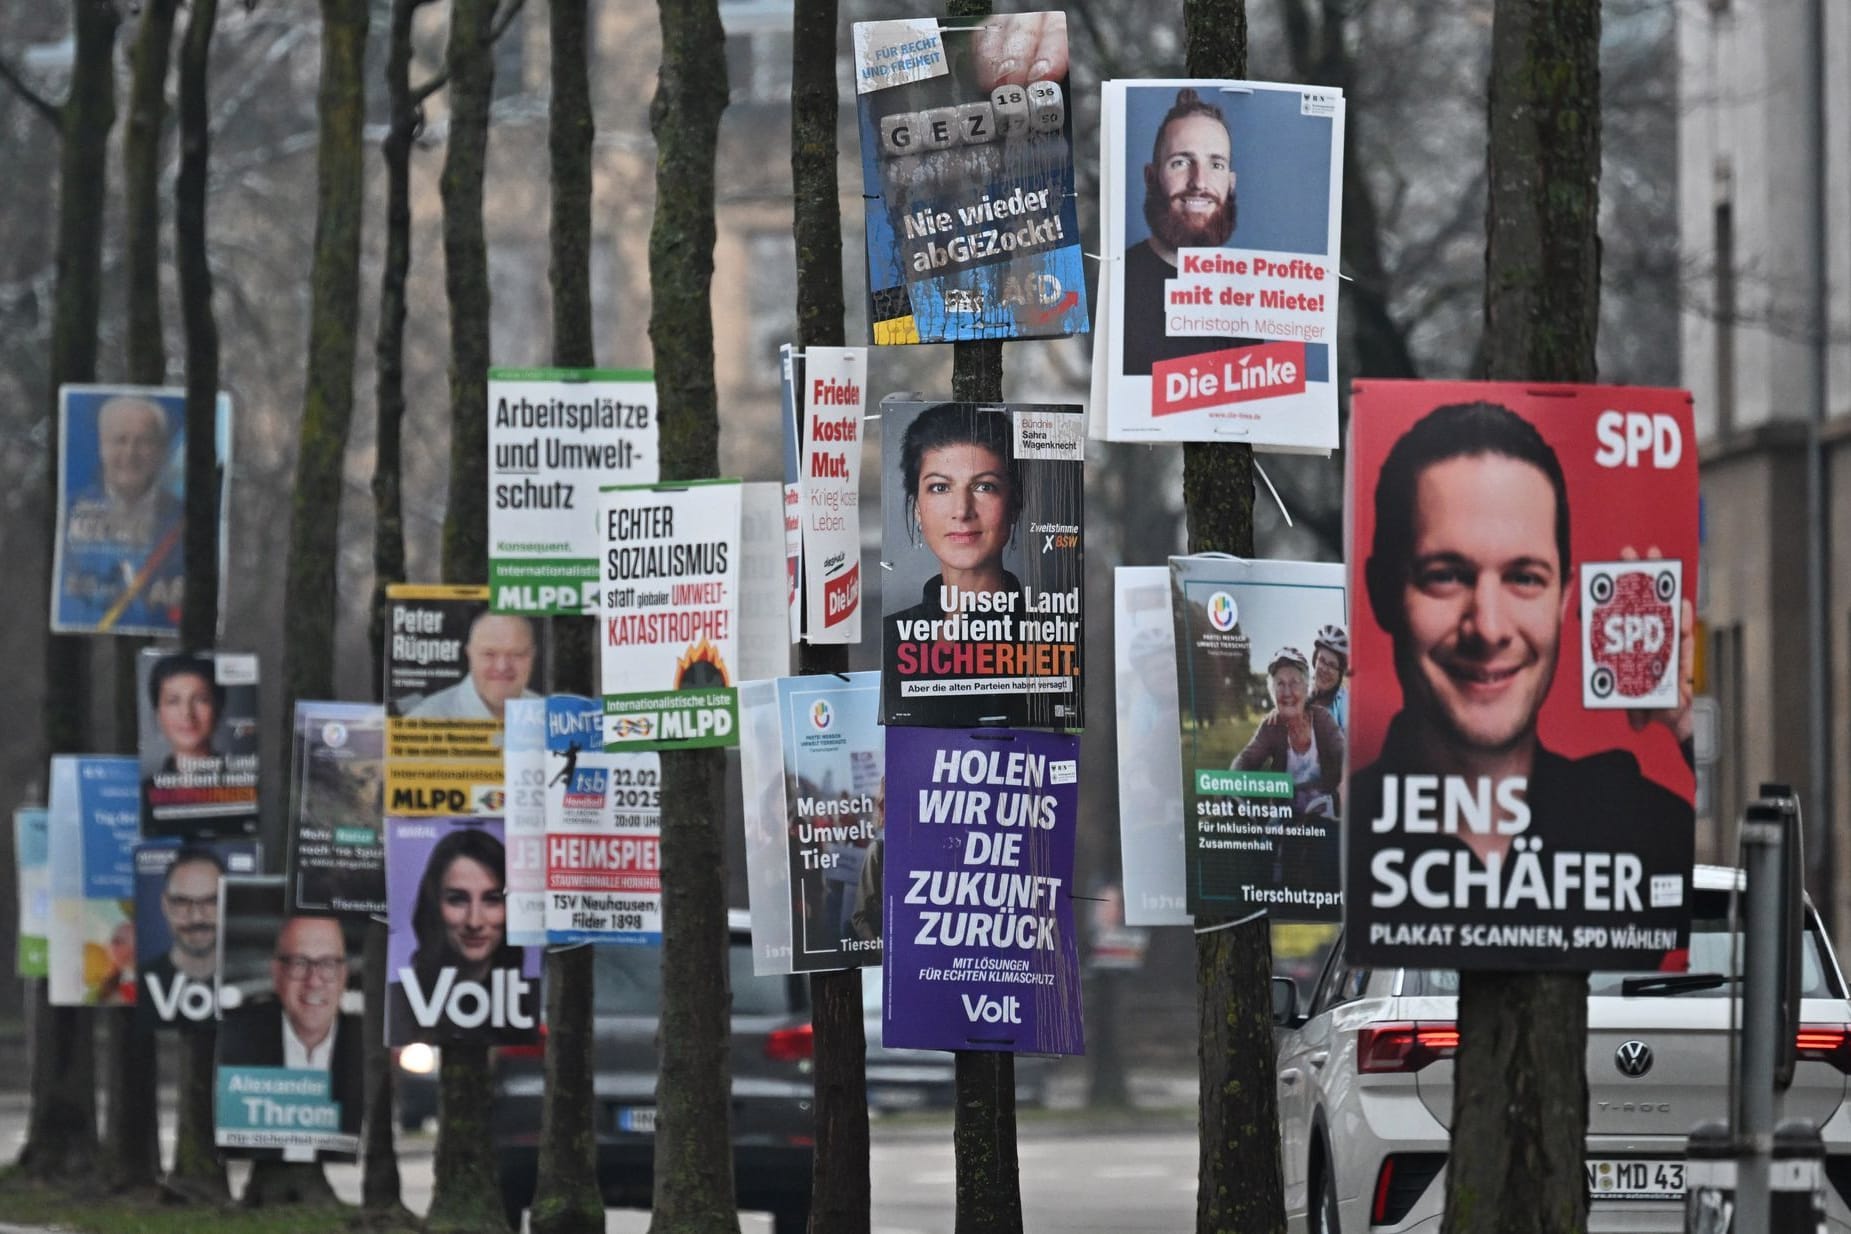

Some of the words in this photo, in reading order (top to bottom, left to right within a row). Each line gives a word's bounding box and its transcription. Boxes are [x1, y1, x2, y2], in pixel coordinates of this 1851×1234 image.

[875, 45, 898, 60] FÜR
[901, 37, 937, 54] RECHT
[862, 64, 888, 79] UND
[891, 52, 941, 73] FREIHEIT
[997, 92, 1022, 106] 18
[1036, 87, 1054, 98] 36
[891, 115, 986, 148] GEZ
[904, 208, 953, 239] Nie
[957, 187, 1049, 227] wieder
[913, 214, 1064, 272] abGEZockt!
[1184, 254, 1248, 275] Keine
[1252, 257, 1325, 281] Profite
[1001, 272, 1062, 307] AfD
[1170, 286, 1213, 306] mit
[1219, 287, 1255, 307] der
[1260, 289, 1325, 313] Miete!
[1170, 315, 1250, 334] Christoph
[1254, 317, 1326, 340] Mössinger
[1166, 367, 1219, 403] Die
[1224, 353, 1297, 393] Linke
[496, 397, 649, 433] Arbeitsplätze
[1022, 418, 1053, 429] Bündnis
[1022, 430, 1047, 440] Sahra
[1022, 440, 1077, 451] Wagenknecht
[1595, 410, 1682, 469] SPD
[496, 438, 540, 472] und
[545, 438, 643, 470] Umwelt-
[811, 451, 849, 484] Mut,
[496, 478, 574, 509] schutz
[811, 488, 839, 512] Krieg
[607, 504, 674, 542] ECHTER
[1030, 522, 1079, 534] Zweitstimme
[1055, 535, 1078, 549] BSW
[608, 541, 728, 581] SOZIALISMUS
[497, 586, 578, 611] MLPD
[607, 588, 635, 609] statt
[637, 592, 669, 610] globaler
[671, 582, 728, 606] UMWELT-
[829, 586, 846, 617] Die
[940, 585, 1019, 614] Unser
[1025, 586, 1079, 614] Land
[393, 604, 444, 634] Peter
[608, 610, 729, 647] KATASTROPHE!
[896, 614, 1013, 641] verdient
[1019, 615, 1079, 643] mehr
[1603, 614, 1664, 653] SPD
[393, 634, 461, 665] Rügner
[896, 642, 1080, 677] SICHERHEIT.
[908, 682, 930, 694] Aber
[932, 681, 947, 692] die
[949, 681, 972, 692] alten
[974, 680, 1010, 691] Parteien
[1012, 679, 1036, 690] haben
[1038, 679, 1068, 691] versagt!
[607, 695, 705, 712] Internationalistische
[706, 694, 732, 706] Liste
[661, 708, 733, 739] MLPD
[576, 770, 605, 793] tsb
[932, 749, 1046, 789] HOLEN
[1200, 773, 1289, 793] Gemeinsam
[392, 788, 466, 812] MLPD
[615, 790, 661, 808] 2025
[797, 794, 874, 816] Mensch
[918, 789, 991, 825] WIR
[995, 791, 1058, 830] UNS
[1197, 800, 1234, 816] statt
[1237, 801, 1293, 819] einsam
[1371, 775, 1532, 835] JENS
[615, 815, 640, 828] 20:00
[799, 821, 875, 843] Umwelt
[1198, 822, 1215, 833] Für
[1216, 822, 1263, 834] Inklusion
[1265, 825, 1283, 835] und
[1285, 825, 1326, 838] sozialen
[963, 831, 1023, 868] DIE
[1198, 837, 1273, 851] Zusammenhalt
[800, 850, 840, 869] Tier
[1371, 836, 1644, 912] SCHÄFER
[553, 895, 578, 910] TSV
[581, 894, 660, 914] Neuhausen/
[904, 870, 1062, 912] ZUKUNFT
[572, 912, 607, 929] Filder
[611, 914, 642, 930] 1898
[914, 906, 1056, 951] ZURÜCK
[1370, 924, 1455, 946] PLAKAT
[1461, 924, 1569, 951] SCANNEN,
[1573, 928, 1607, 948] SPD
[1610, 925, 1678, 951] WÄHLEN!
[919, 967, 942, 981] FÜR
[943, 969, 988, 983] ECHTEN
[988, 971, 1055, 986] KLIMASCHUTZ
[953, 958, 974, 970] MIT
[974, 956, 1030, 972] LÖSUNGEN
[398, 966, 535, 1029] Volt
[961, 994, 1022, 1024] Volt
[228, 1074, 327, 1096] Alexander
[241, 1096, 338, 1127] Throm
[1597, 1101, 1671, 1113] T-ROC
[1616, 1163, 1648, 1190] MD
[1654, 1163, 1684, 1190] 43
